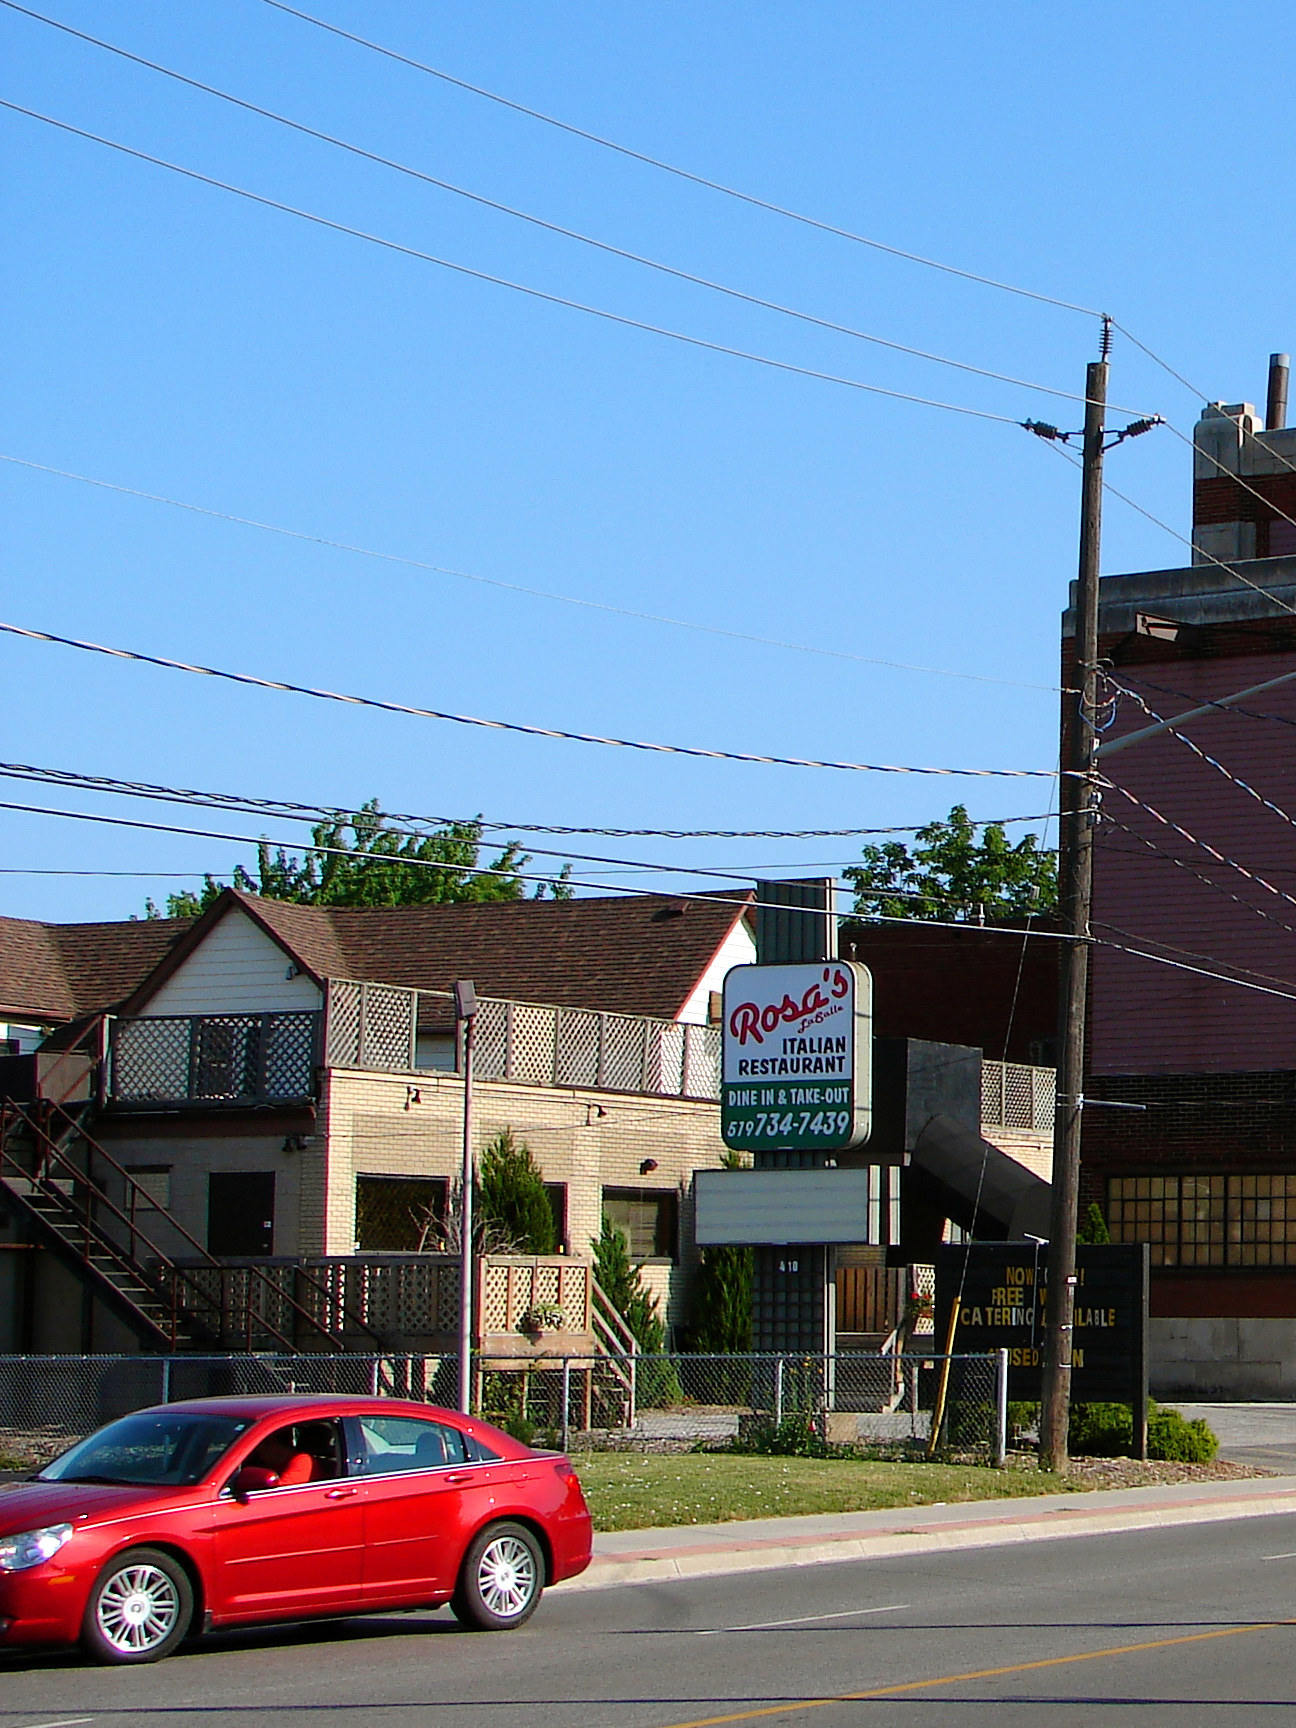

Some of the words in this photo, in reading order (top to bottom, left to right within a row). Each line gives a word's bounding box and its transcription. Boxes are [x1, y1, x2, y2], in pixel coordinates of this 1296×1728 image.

[729, 967, 849, 1046] Rosa's
[797, 1005, 844, 1034] LaSalle
[782, 1035, 846, 1055] ITALIAN
[738, 1055, 846, 1076] RESTAURANT
[728, 1089, 757, 1107] DINE
[761, 1088, 774, 1106] IN
[777, 1088, 787, 1105] &
[790, 1086, 850, 1105] TAKE-OUT
[727, 1120, 754, 1138] 519
[755, 1110, 849, 1137] 734-7439
[779, 1260, 799, 1273] 410
[1006, 1267, 1034, 1286] NOW
[991, 1287, 1024, 1306] FREE
[961, 1307, 1034, 1326] CATERING
